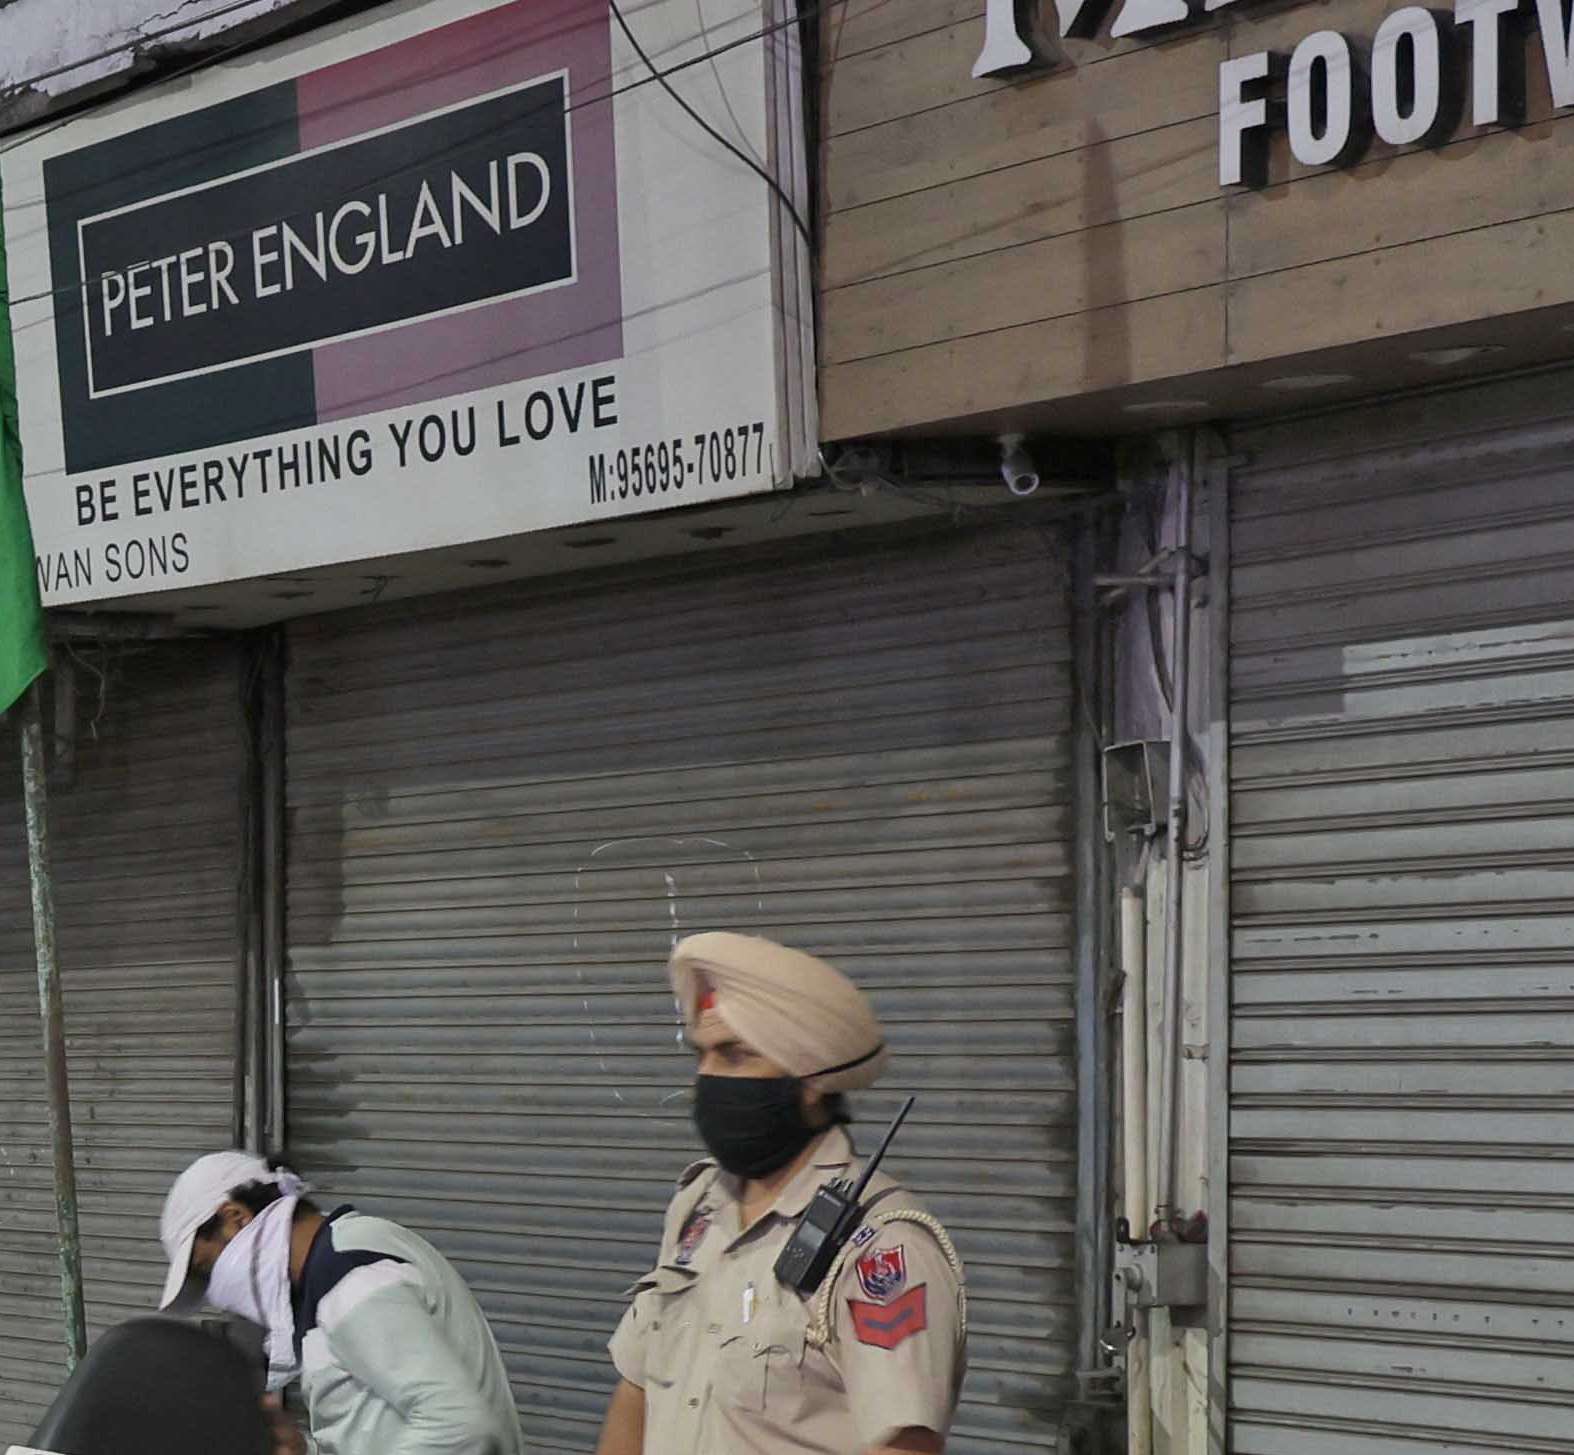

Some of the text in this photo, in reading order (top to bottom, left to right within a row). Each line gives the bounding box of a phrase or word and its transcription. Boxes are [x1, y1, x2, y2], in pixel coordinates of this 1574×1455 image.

[101, 151, 551, 337] PETER ENGLAND
[75, 375, 618, 526] BE EVERYTHING YOU LOVE
[589, 422, 766, 504] M:95695-70877
[105, 532, 190, 582] SONS
